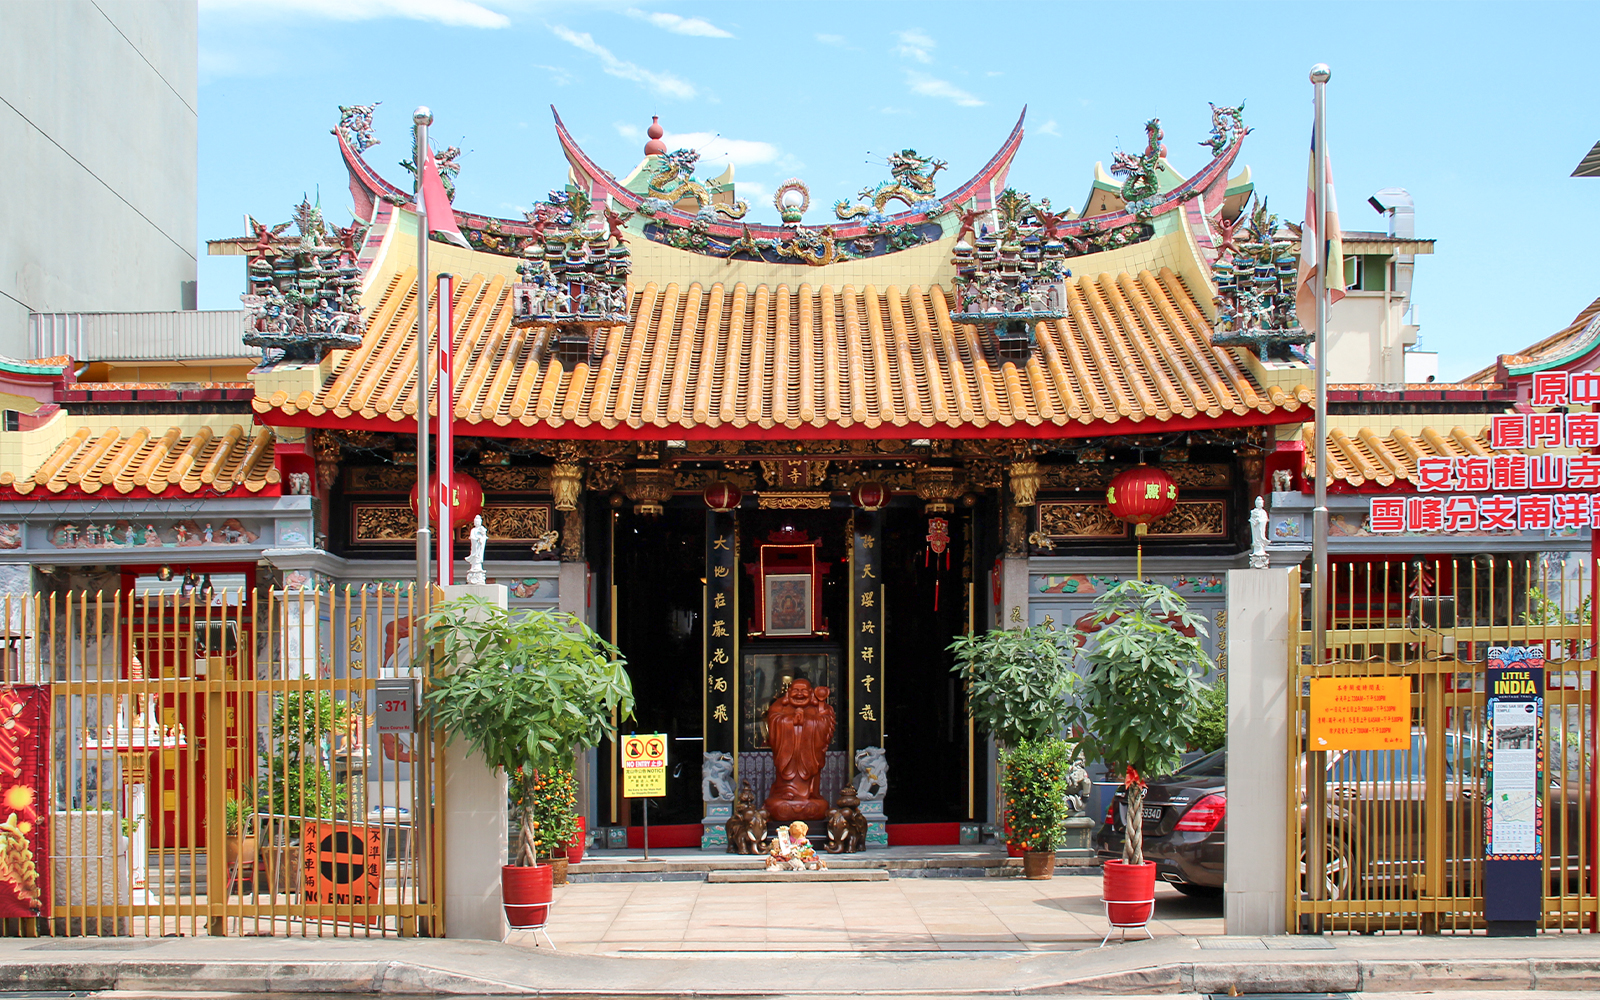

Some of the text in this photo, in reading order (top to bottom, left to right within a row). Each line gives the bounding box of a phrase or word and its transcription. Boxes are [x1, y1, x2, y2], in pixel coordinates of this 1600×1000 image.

[1532, 371, 1600, 406] 原中
[1491, 412, 1600, 449] 廈門南
[1418, 454, 1600, 492] 安海龍山寺
[1501, 671, 1530, 680] LITTLE
[1494, 680, 1537, 695] INDIA
[385, 700, 407, 712] 371
[306, 891, 322, 903] NO
